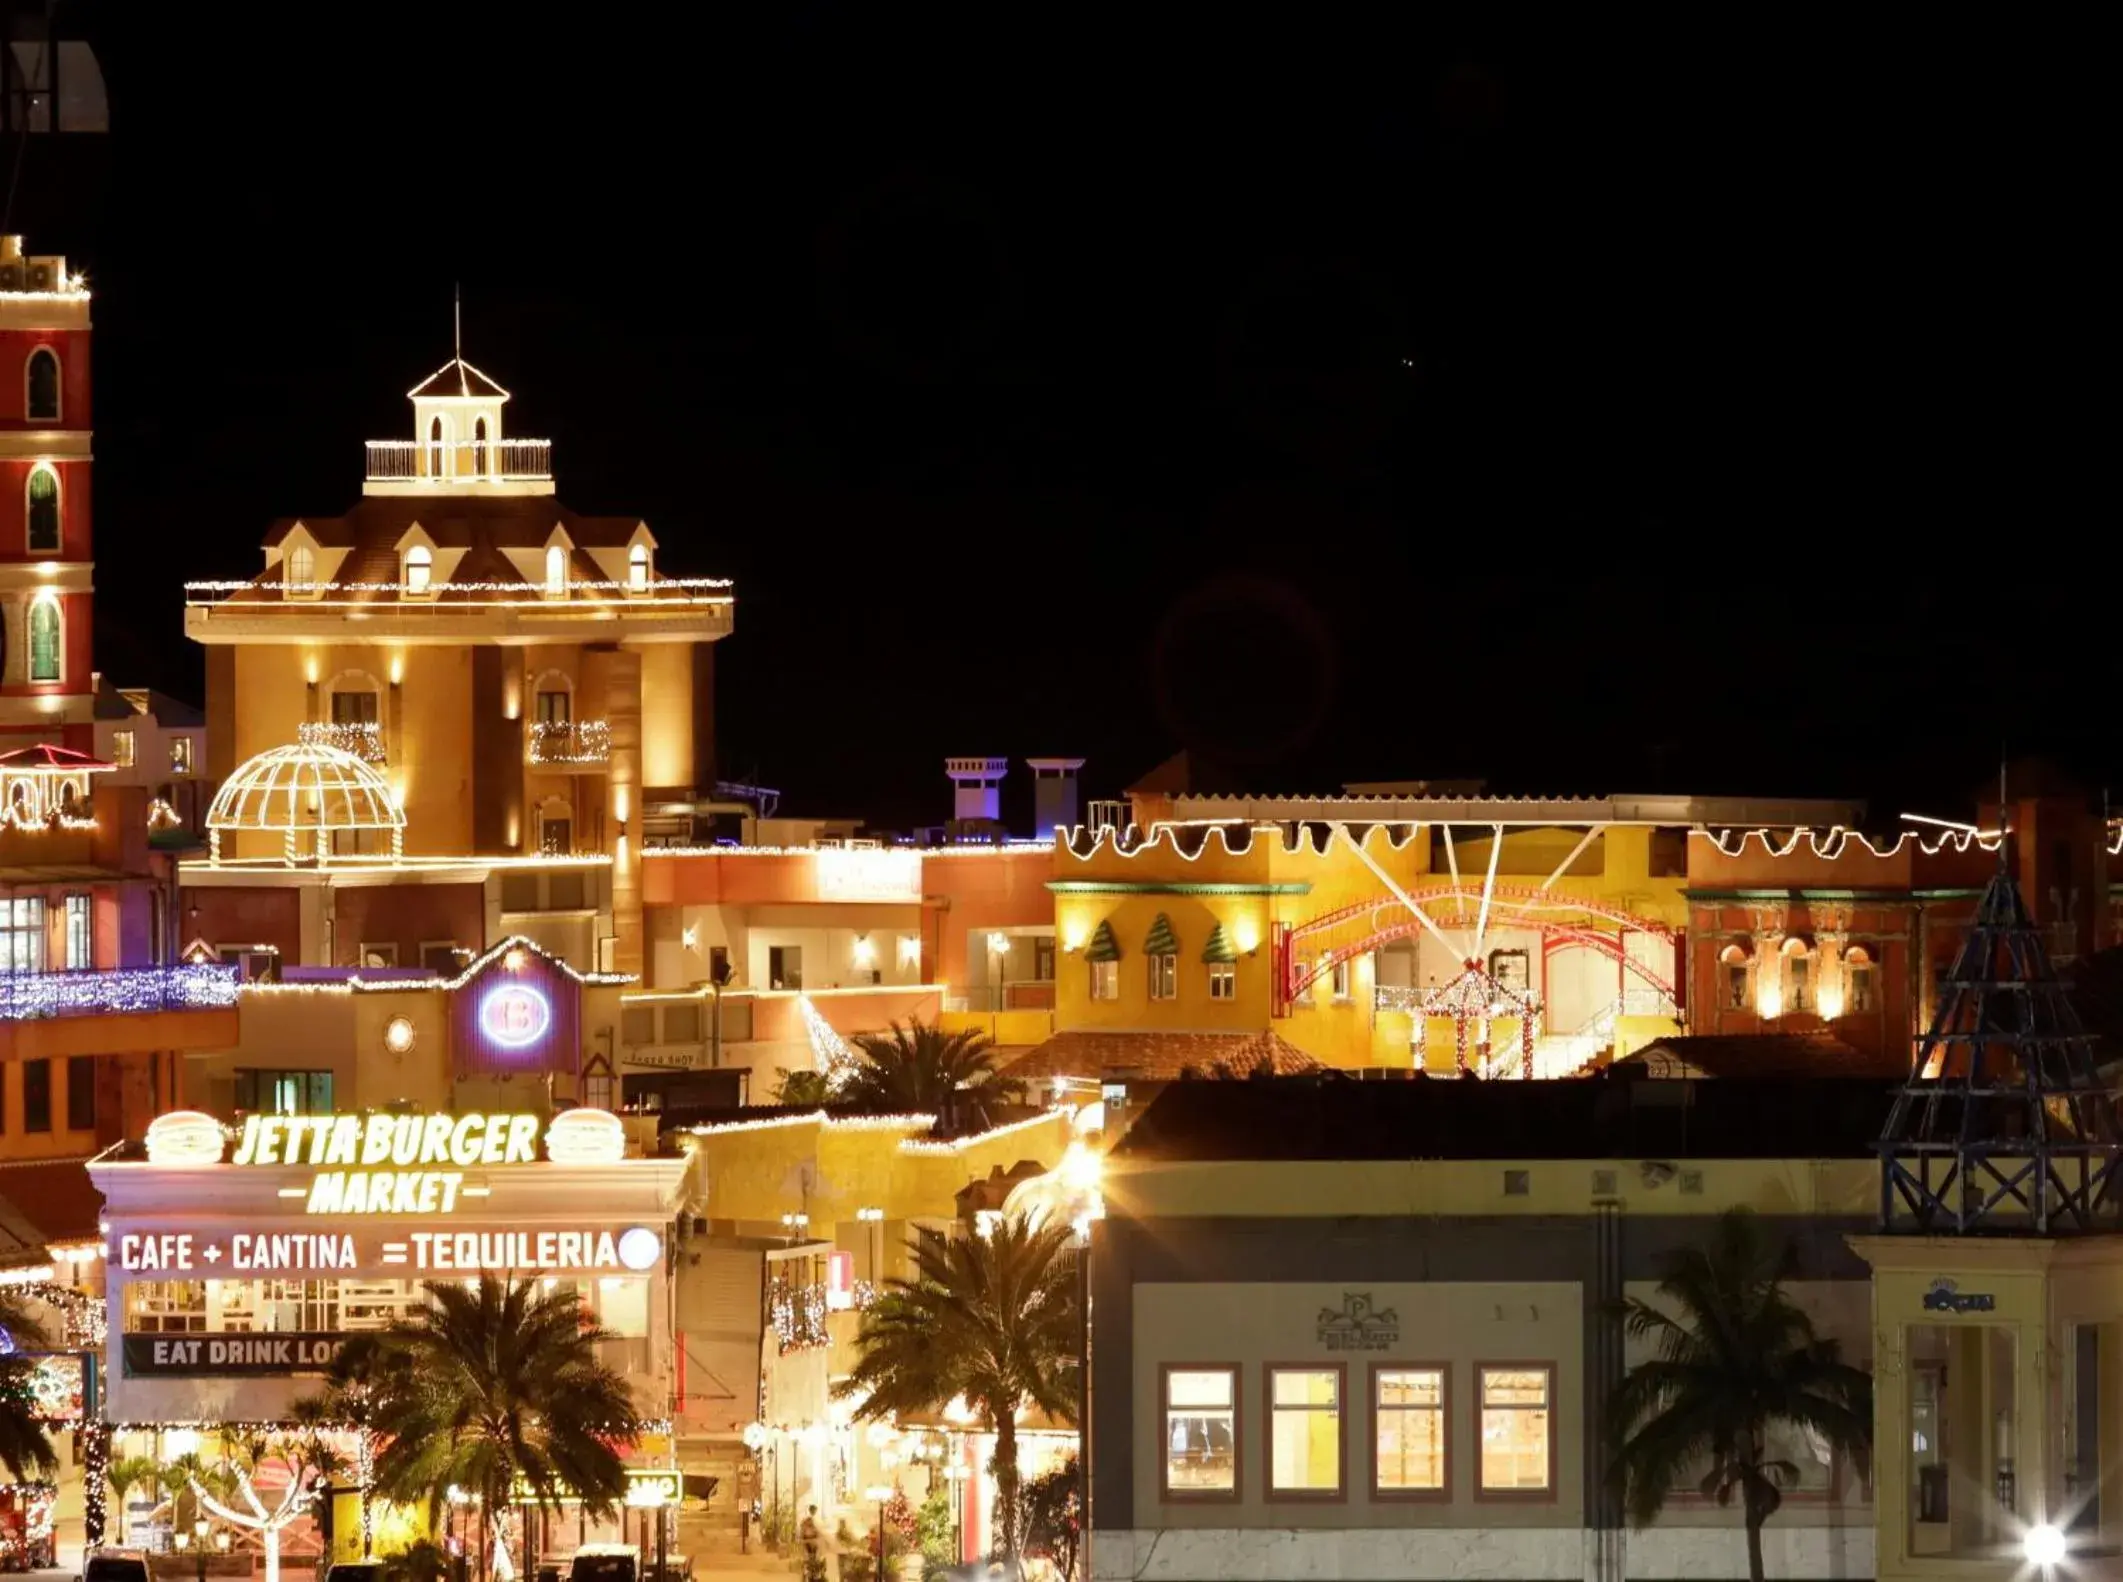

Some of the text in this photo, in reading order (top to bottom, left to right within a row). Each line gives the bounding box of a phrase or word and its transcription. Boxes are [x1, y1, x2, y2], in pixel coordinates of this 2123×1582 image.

[232, 1113, 539, 1165] JETTA BURGER
[306, 1171, 463, 1213] MARKET
[121, 1234, 194, 1270] CAFE
[232, 1234, 358, 1269] CANTINA
[410, 1232, 619, 1269] TEQUILERIA
[153, 1340, 202, 1365] EAT
[209, 1340, 291, 1365] DRINK
